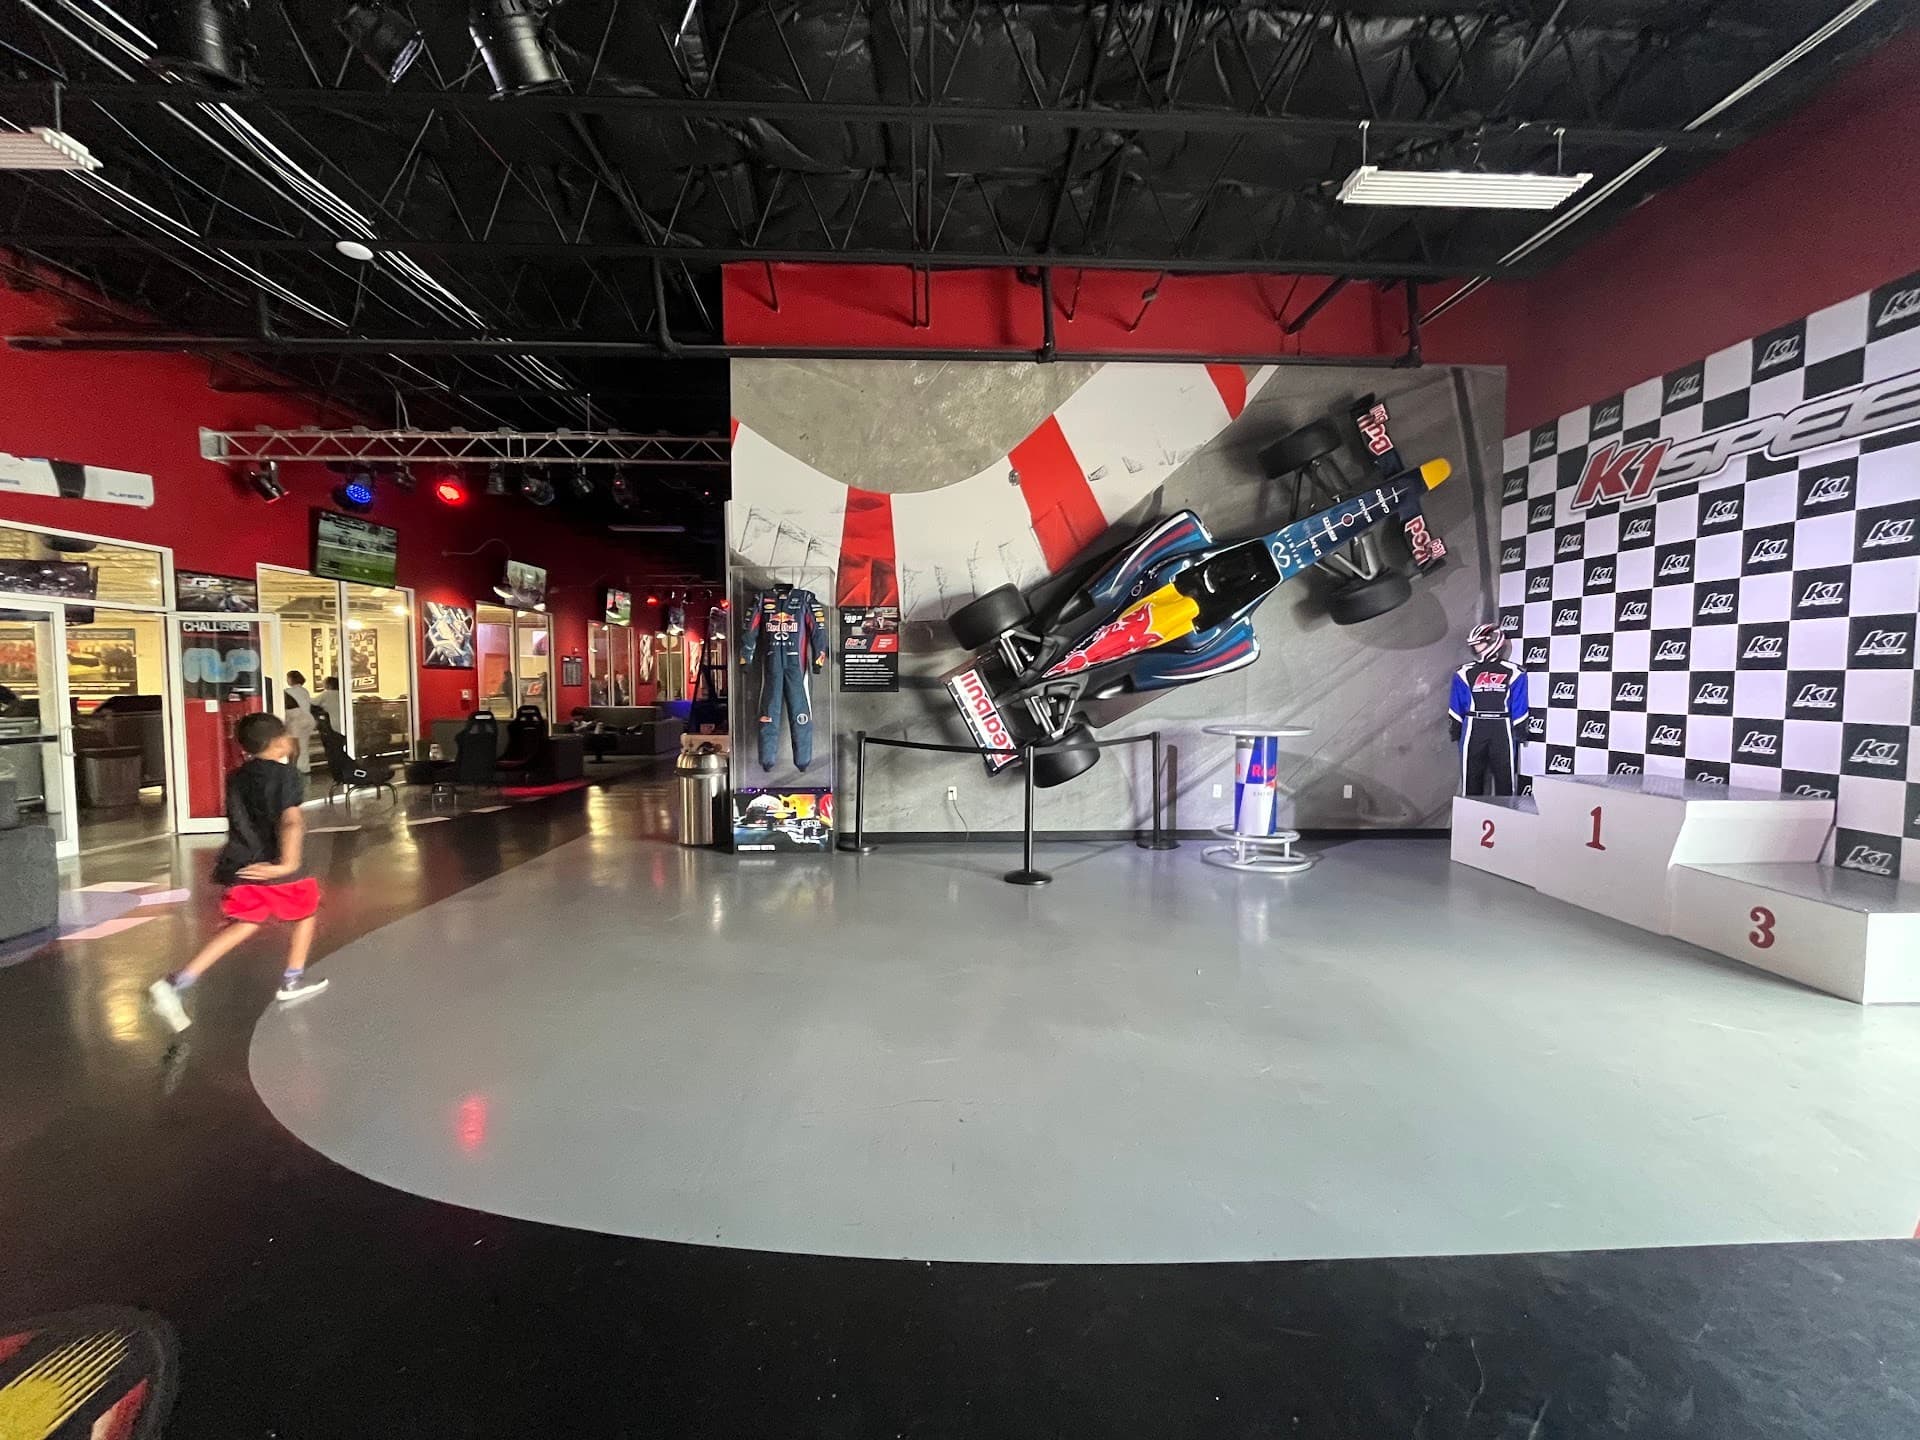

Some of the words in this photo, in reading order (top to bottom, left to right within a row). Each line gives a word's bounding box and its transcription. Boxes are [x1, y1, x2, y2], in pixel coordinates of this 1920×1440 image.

[1765, 335, 1800, 361] K1
[1571, 440, 1671, 508] K1
[1807, 476, 1851, 499] K1
[1705, 500, 1739, 521] K1
[1626, 519, 1653, 538] K1
[1867, 519, 1915, 540] K1
[1560, 534, 1582, 550] K1
[1751, 539, 1788, 559] K1
[1661, 554, 1690, 572] K1
[1530, 576, 1550, 591] K1
[1588, 567, 1614, 584] K1
[1801, 582, 1844, 601] K1
[1622, 602, 1648, 619] K1
[1702, 593, 1734, 611] K1
[1557, 609, 1578, 625] K1
[766, 623, 781, 632] Red
[781, 622, 798, 632] Bull
[1659, 640, 1687, 656] K1
[1748, 636, 1783, 654] K1
[1860, 630, 1907, 649] K1
[1587, 644, 1610, 659] K1
[961, 673, 992, 716] Bull
[1553, 682, 1575, 696] K1
[1618, 683, 1644, 698] K1
[1696, 683, 1730, 699] K1
[1797, 684, 1838, 702] K1
[1655, 725, 1682, 741] K1
[1741, 731, 1777, 750] K1
[1853, 739, 1900, 759] K1
[1481, 820, 1495, 848] 2
[1586, 806, 1606, 850] 1
[1848, 846, 1892, 867] K1
[1749, 906, 1776, 948] 3
